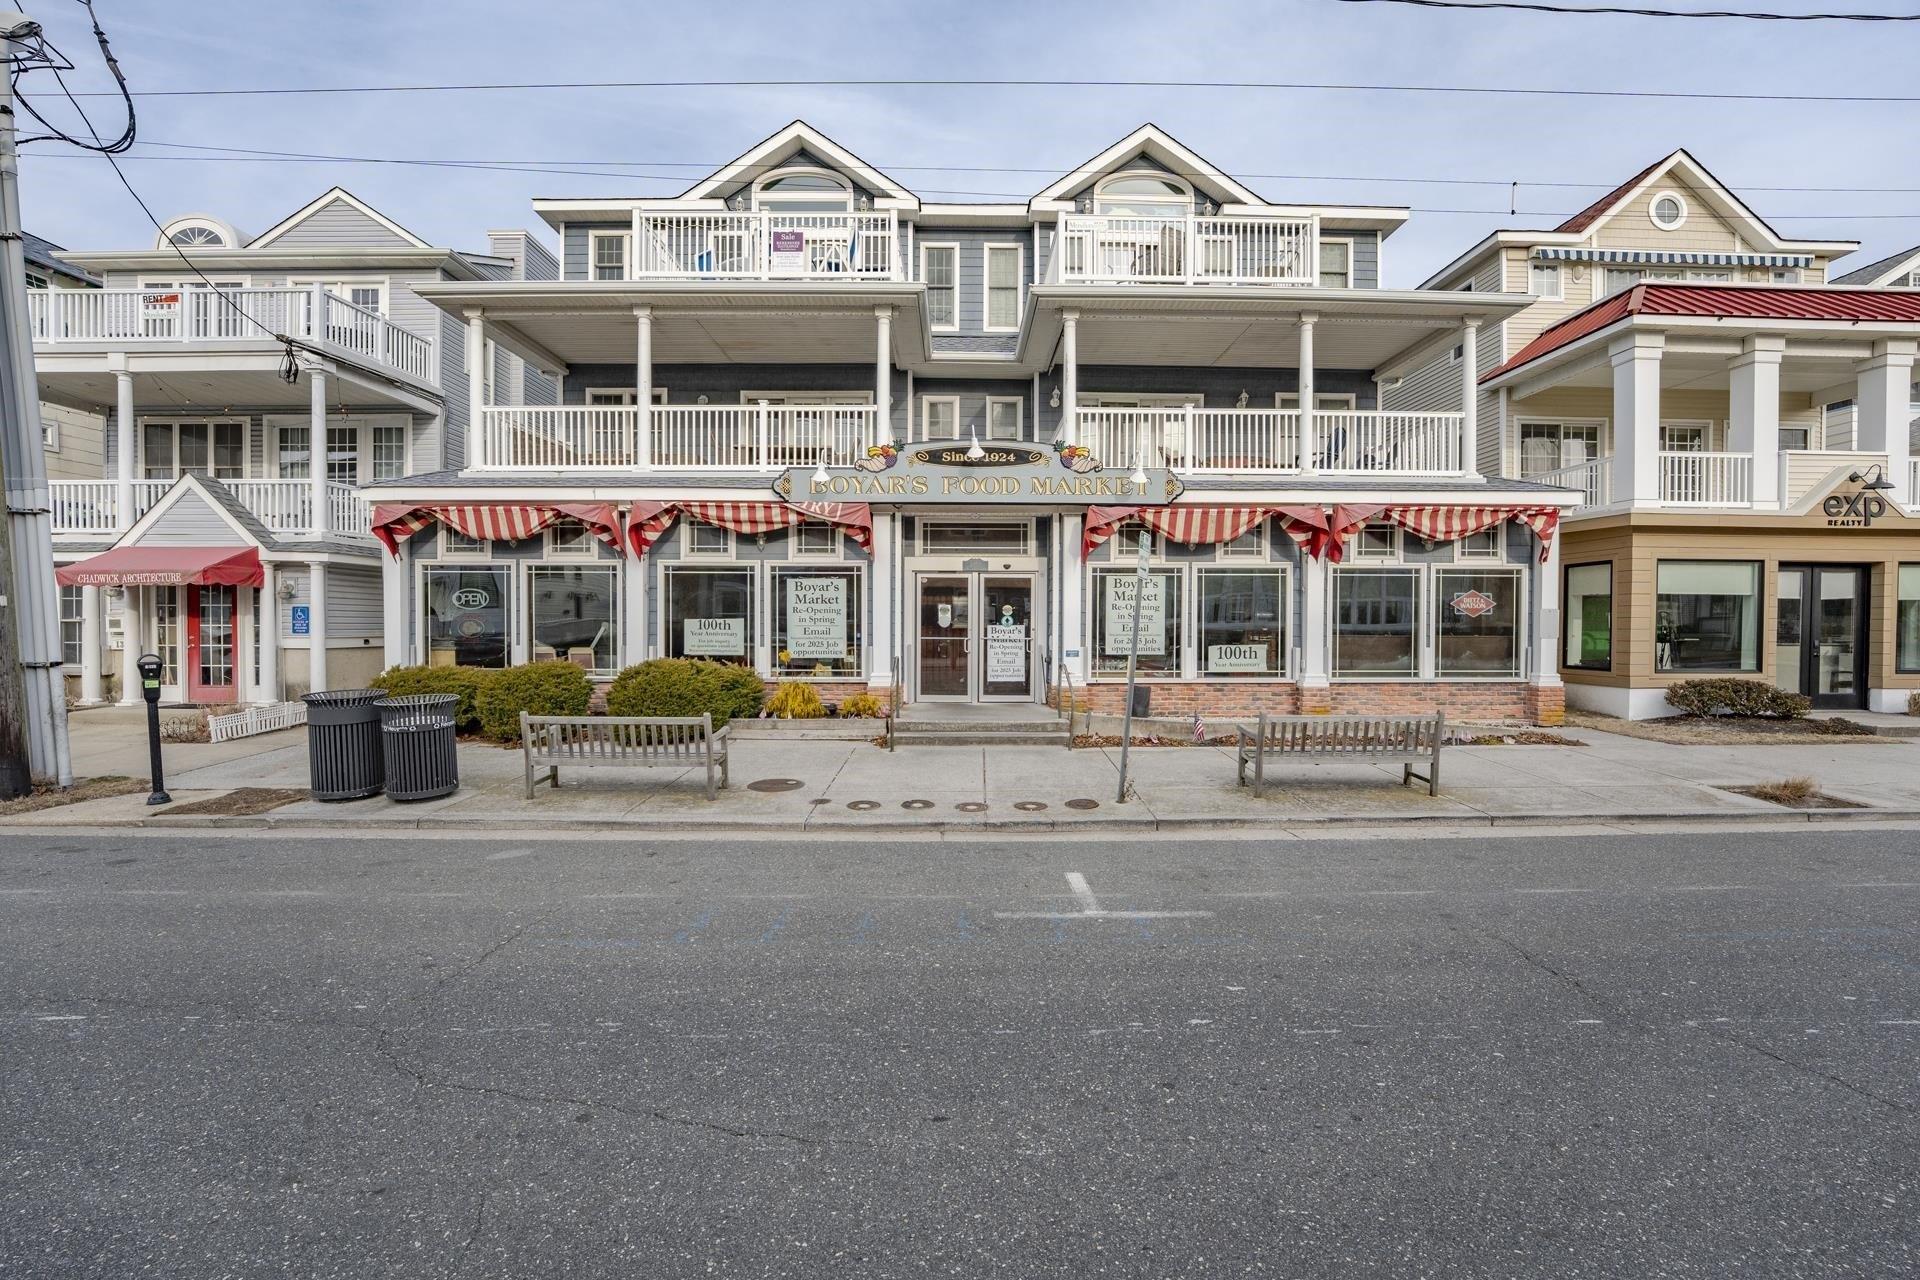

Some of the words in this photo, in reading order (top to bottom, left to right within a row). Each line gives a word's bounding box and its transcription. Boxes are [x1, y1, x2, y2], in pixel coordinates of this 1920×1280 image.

[143, 295, 163, 303] RENT
[984, 452, 1016, 462] 1924
[809, 475, 929, 495] BOYAR'S
[941, 475, 1021, 496] FOOD
[1030, 476, 1152, 496] MARKET
[797, 500, 834, 516] TRY
[1827, 519, 1863, 527] REALTY
[77, 573, 120, 584] CHADWICK
[122, 572, 182, 583] ARCHITECTURE
[794, 580, 840, 595] Boyar's
[1112, 577, 1159, 592] Boyr's
[455, 593, 487, 605] OPEN
[794, 593, 840, 605] Market
[792, 606, 842, 616] Re-Opening
[1111, 603, 1160, 613] Re-Opning
[798, 615, 807, 623] in
[808, 615, 836, 625] Spring
[1117, 612, 1126, 620] in
[1127, 612, 1154, 621] Sping
[697, 619, 731, 631] 100th
[803, 626, 831, 636] Email
[990, 626, 1022, 637] Boyar's
[795, 640, 806, 648] for
[807, 640, 825, 648] 2025
[825, 640, 839, 650] Job
[1113, 637, 1125, 645] for
[1126, 637, 1143, 645] 25
[1144, 637, 1157, 646] Job
[793, 649, 843, 657] opportunities
[1111, 646, 1161, 654] opporunities
[1216, 646, 1258, 660] 100th
